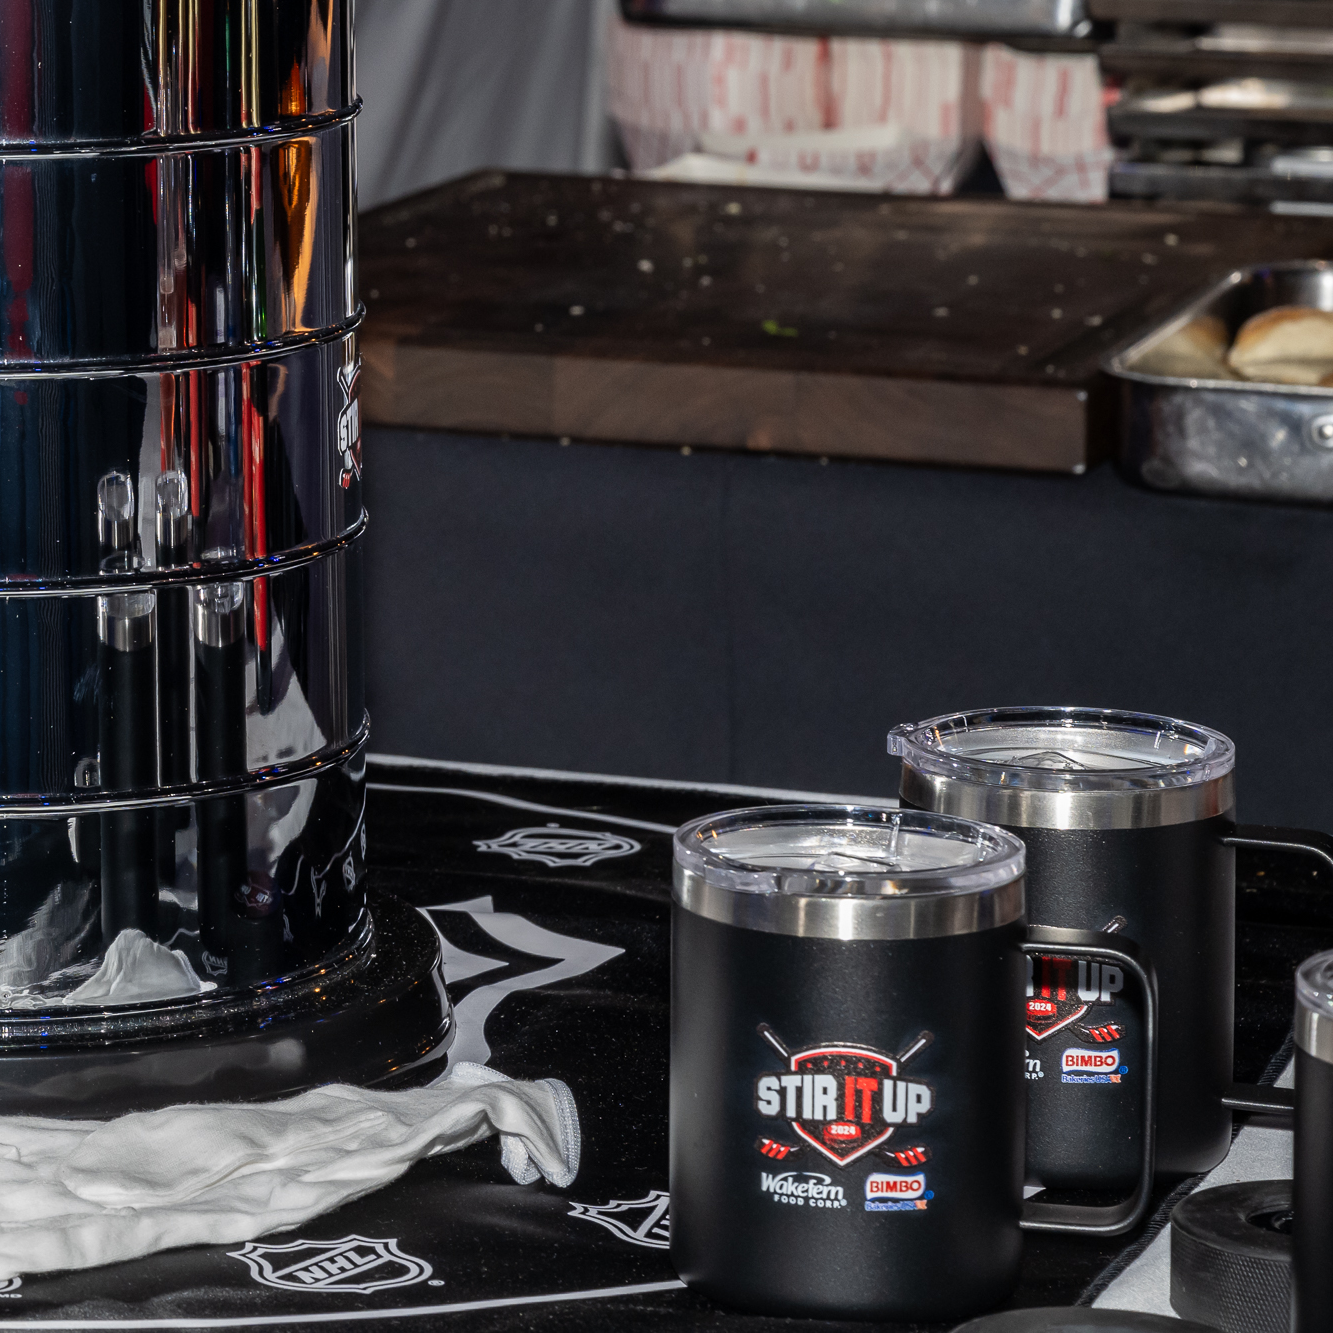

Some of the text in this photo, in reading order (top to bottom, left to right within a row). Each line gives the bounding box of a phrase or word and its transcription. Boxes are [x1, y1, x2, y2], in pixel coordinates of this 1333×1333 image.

[1041, 956, 1073, 1001] IT
[1077, 960, 1125, 1002] UP
[1028, 1001, 1052, 1012] 2024
[1064, 1054, 1117, 1068] BIMBO
[757, 1074, 932, 1124] STIR IT UP
[830, 1124, 857, 1135] 2024
[761, 1171, 845, 1200] Wakefern
[869, 1179, 923, 1194] BIMBO
[773, 1194, 805, 1206] FOOD
[292, 1250, 378, 1284] NHL
